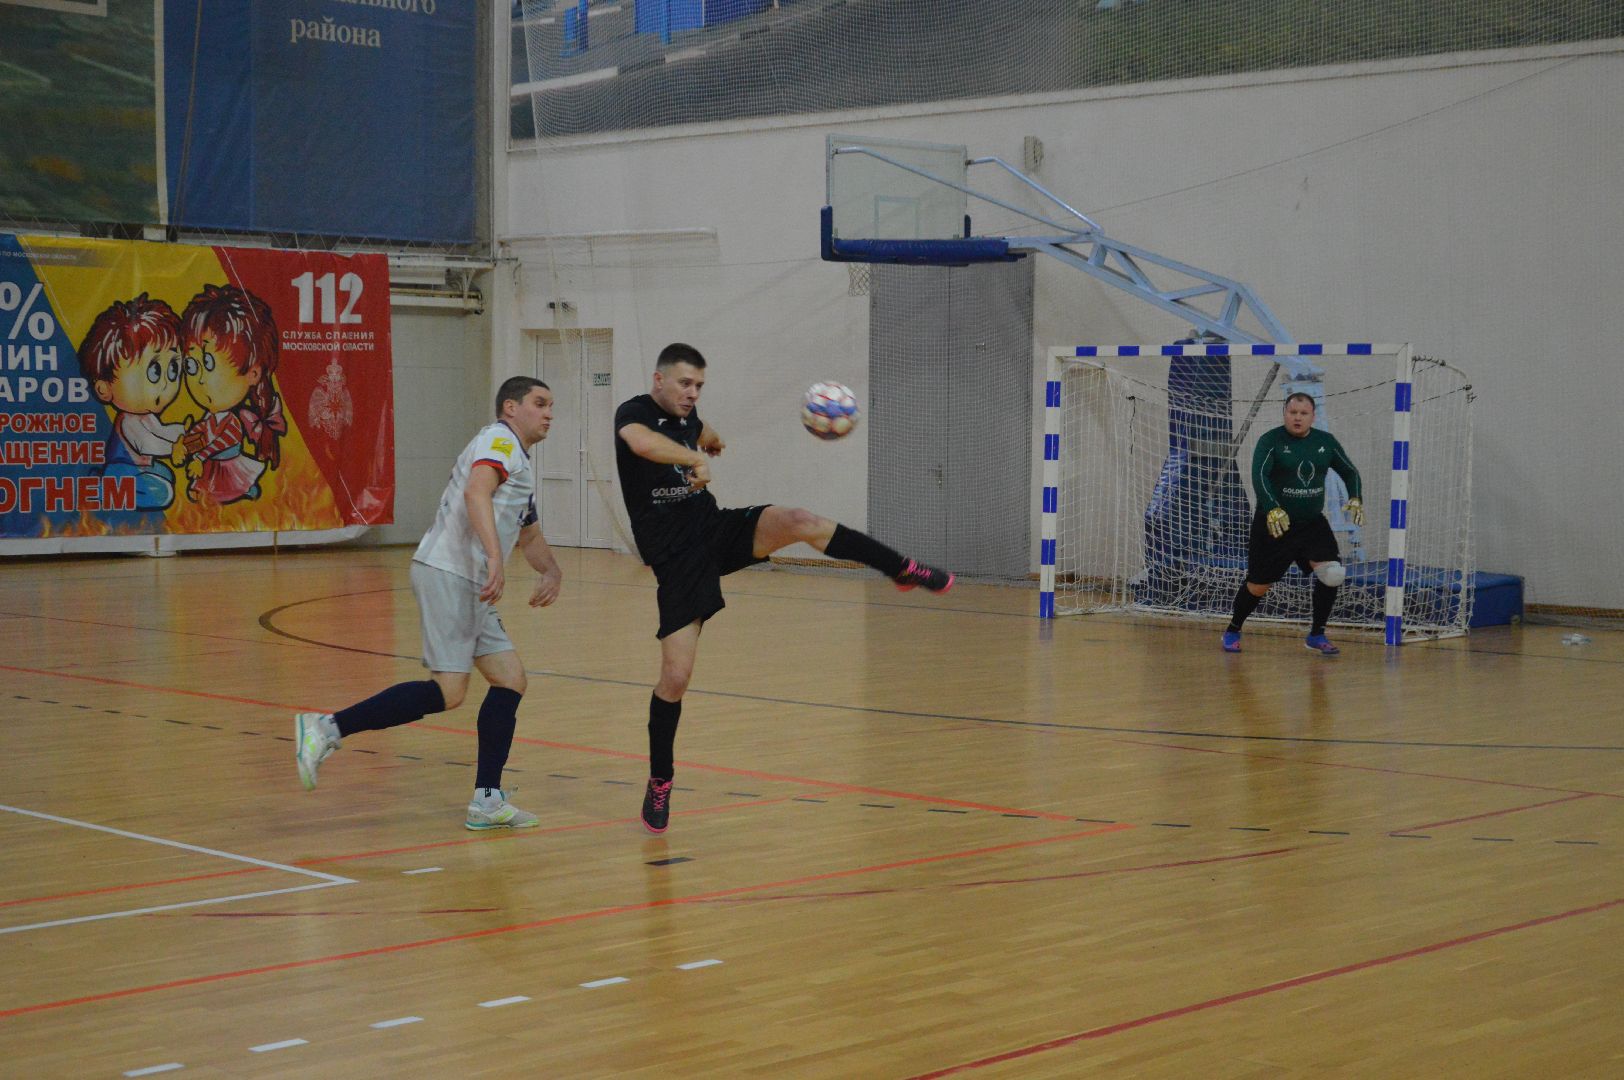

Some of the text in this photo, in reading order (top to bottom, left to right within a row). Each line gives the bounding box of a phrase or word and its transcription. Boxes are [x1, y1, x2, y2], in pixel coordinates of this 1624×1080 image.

[332, 0, 437, 15] ного
[290, 15, 381, 48] района
[291, 271, 364, 324] 112
[282, 331, 321, 340] СЛУЖБА
[282, 341, 375, 352] МОСКОВСКОЙ ОАСТИ
[0, 344, 58, 371] ИН
[0, 440, 106, 470] ЩЕНИЕ
[1282, 487, 1308, 495] GOLDEN
